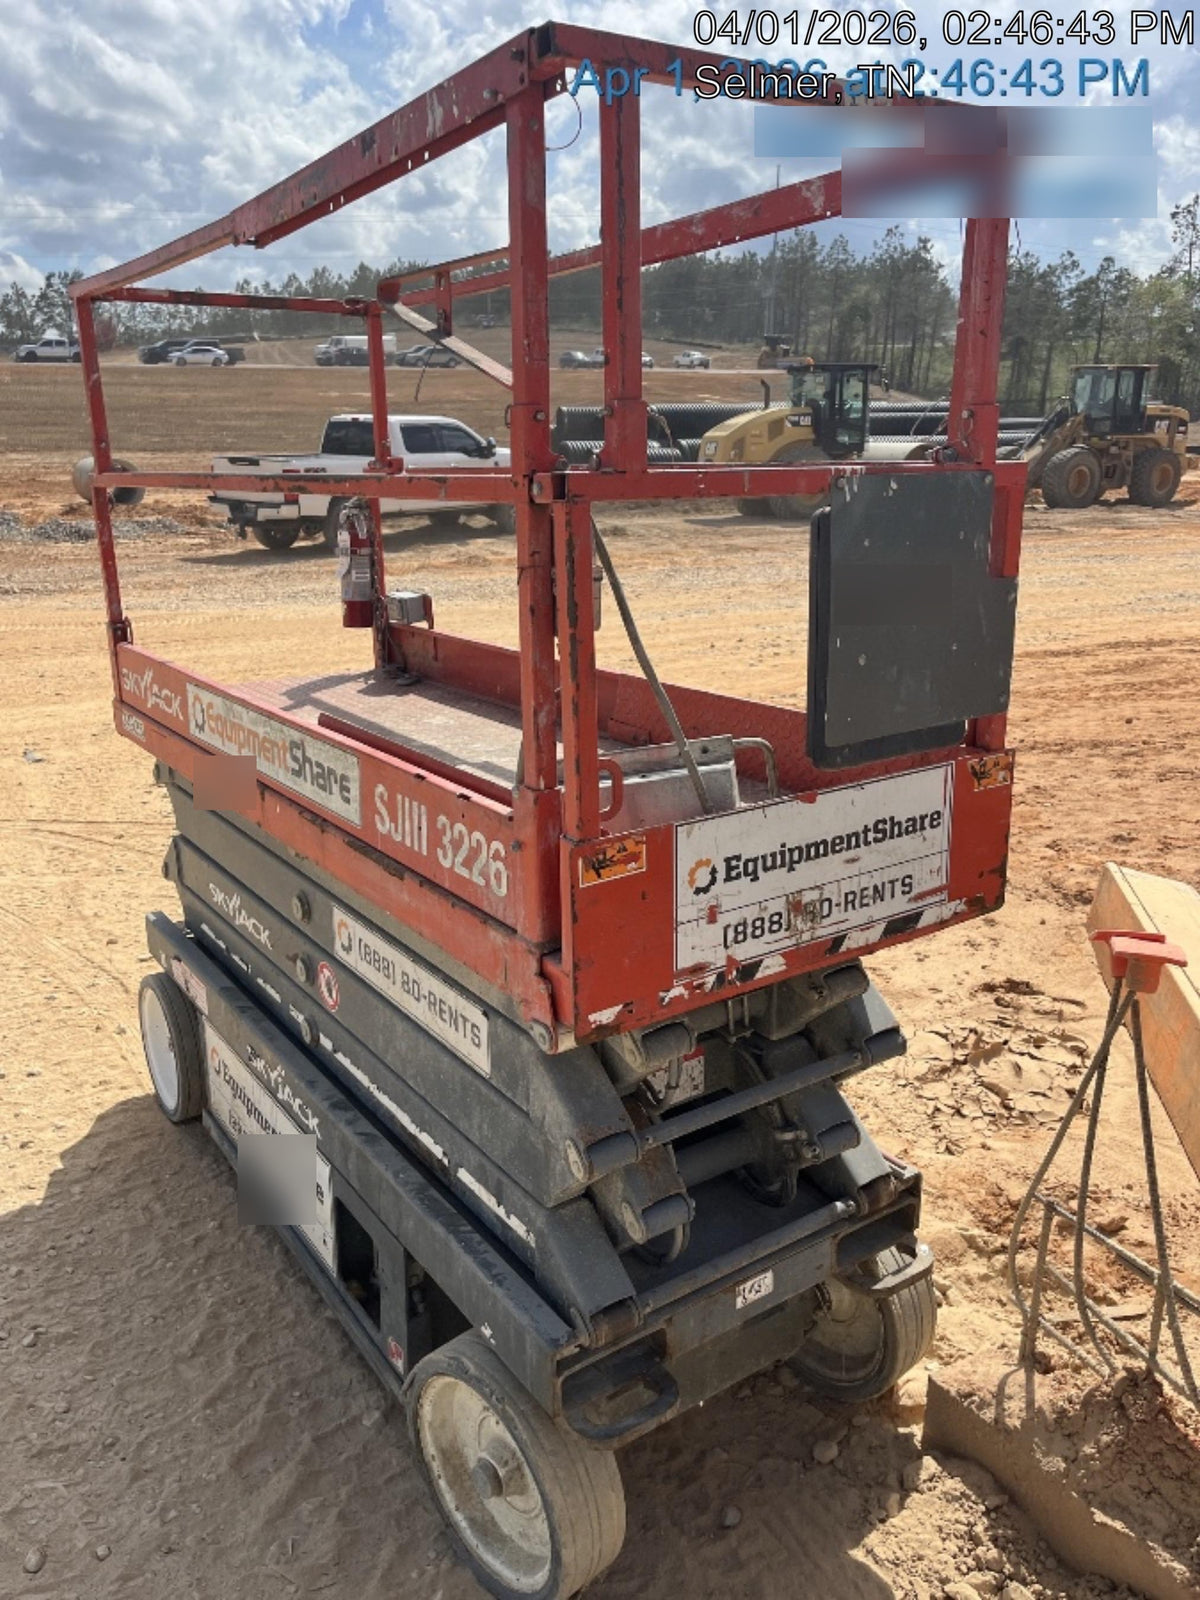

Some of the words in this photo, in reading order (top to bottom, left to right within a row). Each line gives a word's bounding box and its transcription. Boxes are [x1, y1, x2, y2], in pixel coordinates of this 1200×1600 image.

[122, 666, 184, 721] SKYJACK
[205, 701, 351, 806] EquipmentShare
[436, 815, 508, 897] 3226
[722, 809, 942, 884] EquipmentShare
[208, 882, 273, 951] SKYJACK
[358, 938, 396, 986] (888)
